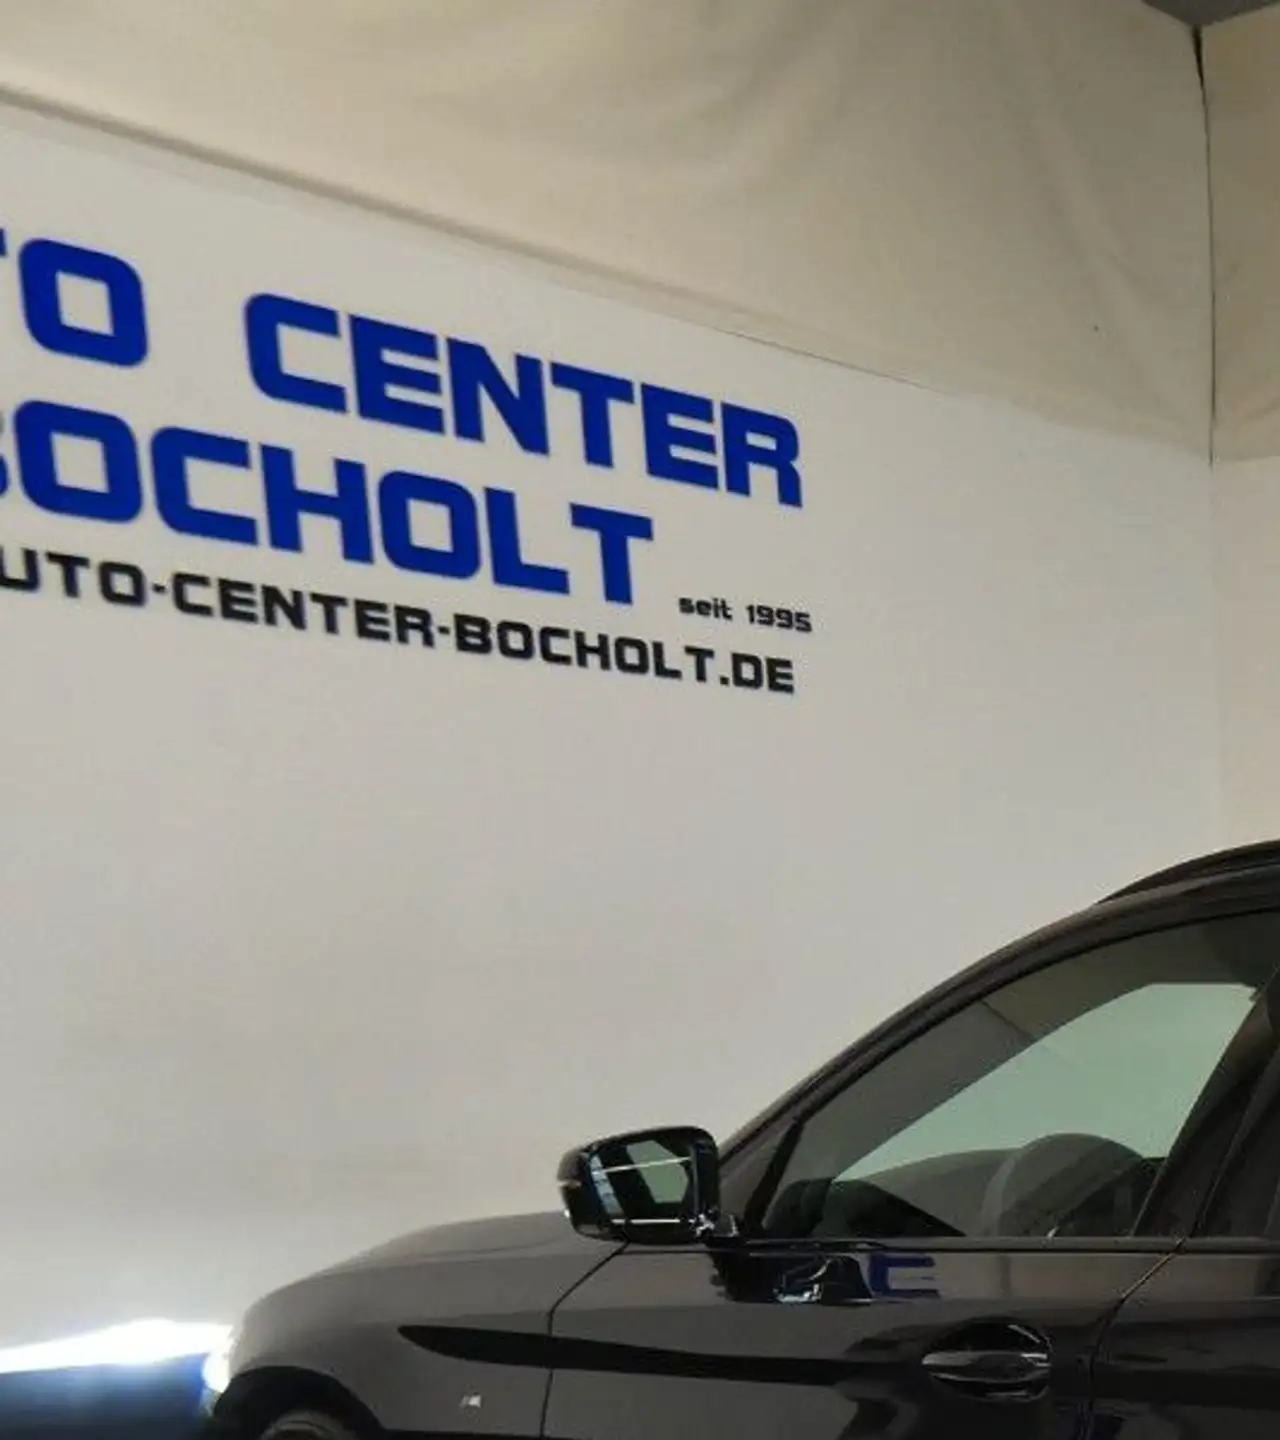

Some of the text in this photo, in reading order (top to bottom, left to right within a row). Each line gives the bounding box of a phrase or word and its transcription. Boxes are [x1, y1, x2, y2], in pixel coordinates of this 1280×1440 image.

[0, 229, 803, 509] O CENTER
[0, 399, 654, 606] OCHOLT
[678, 597, 813, 633] seit 1995
